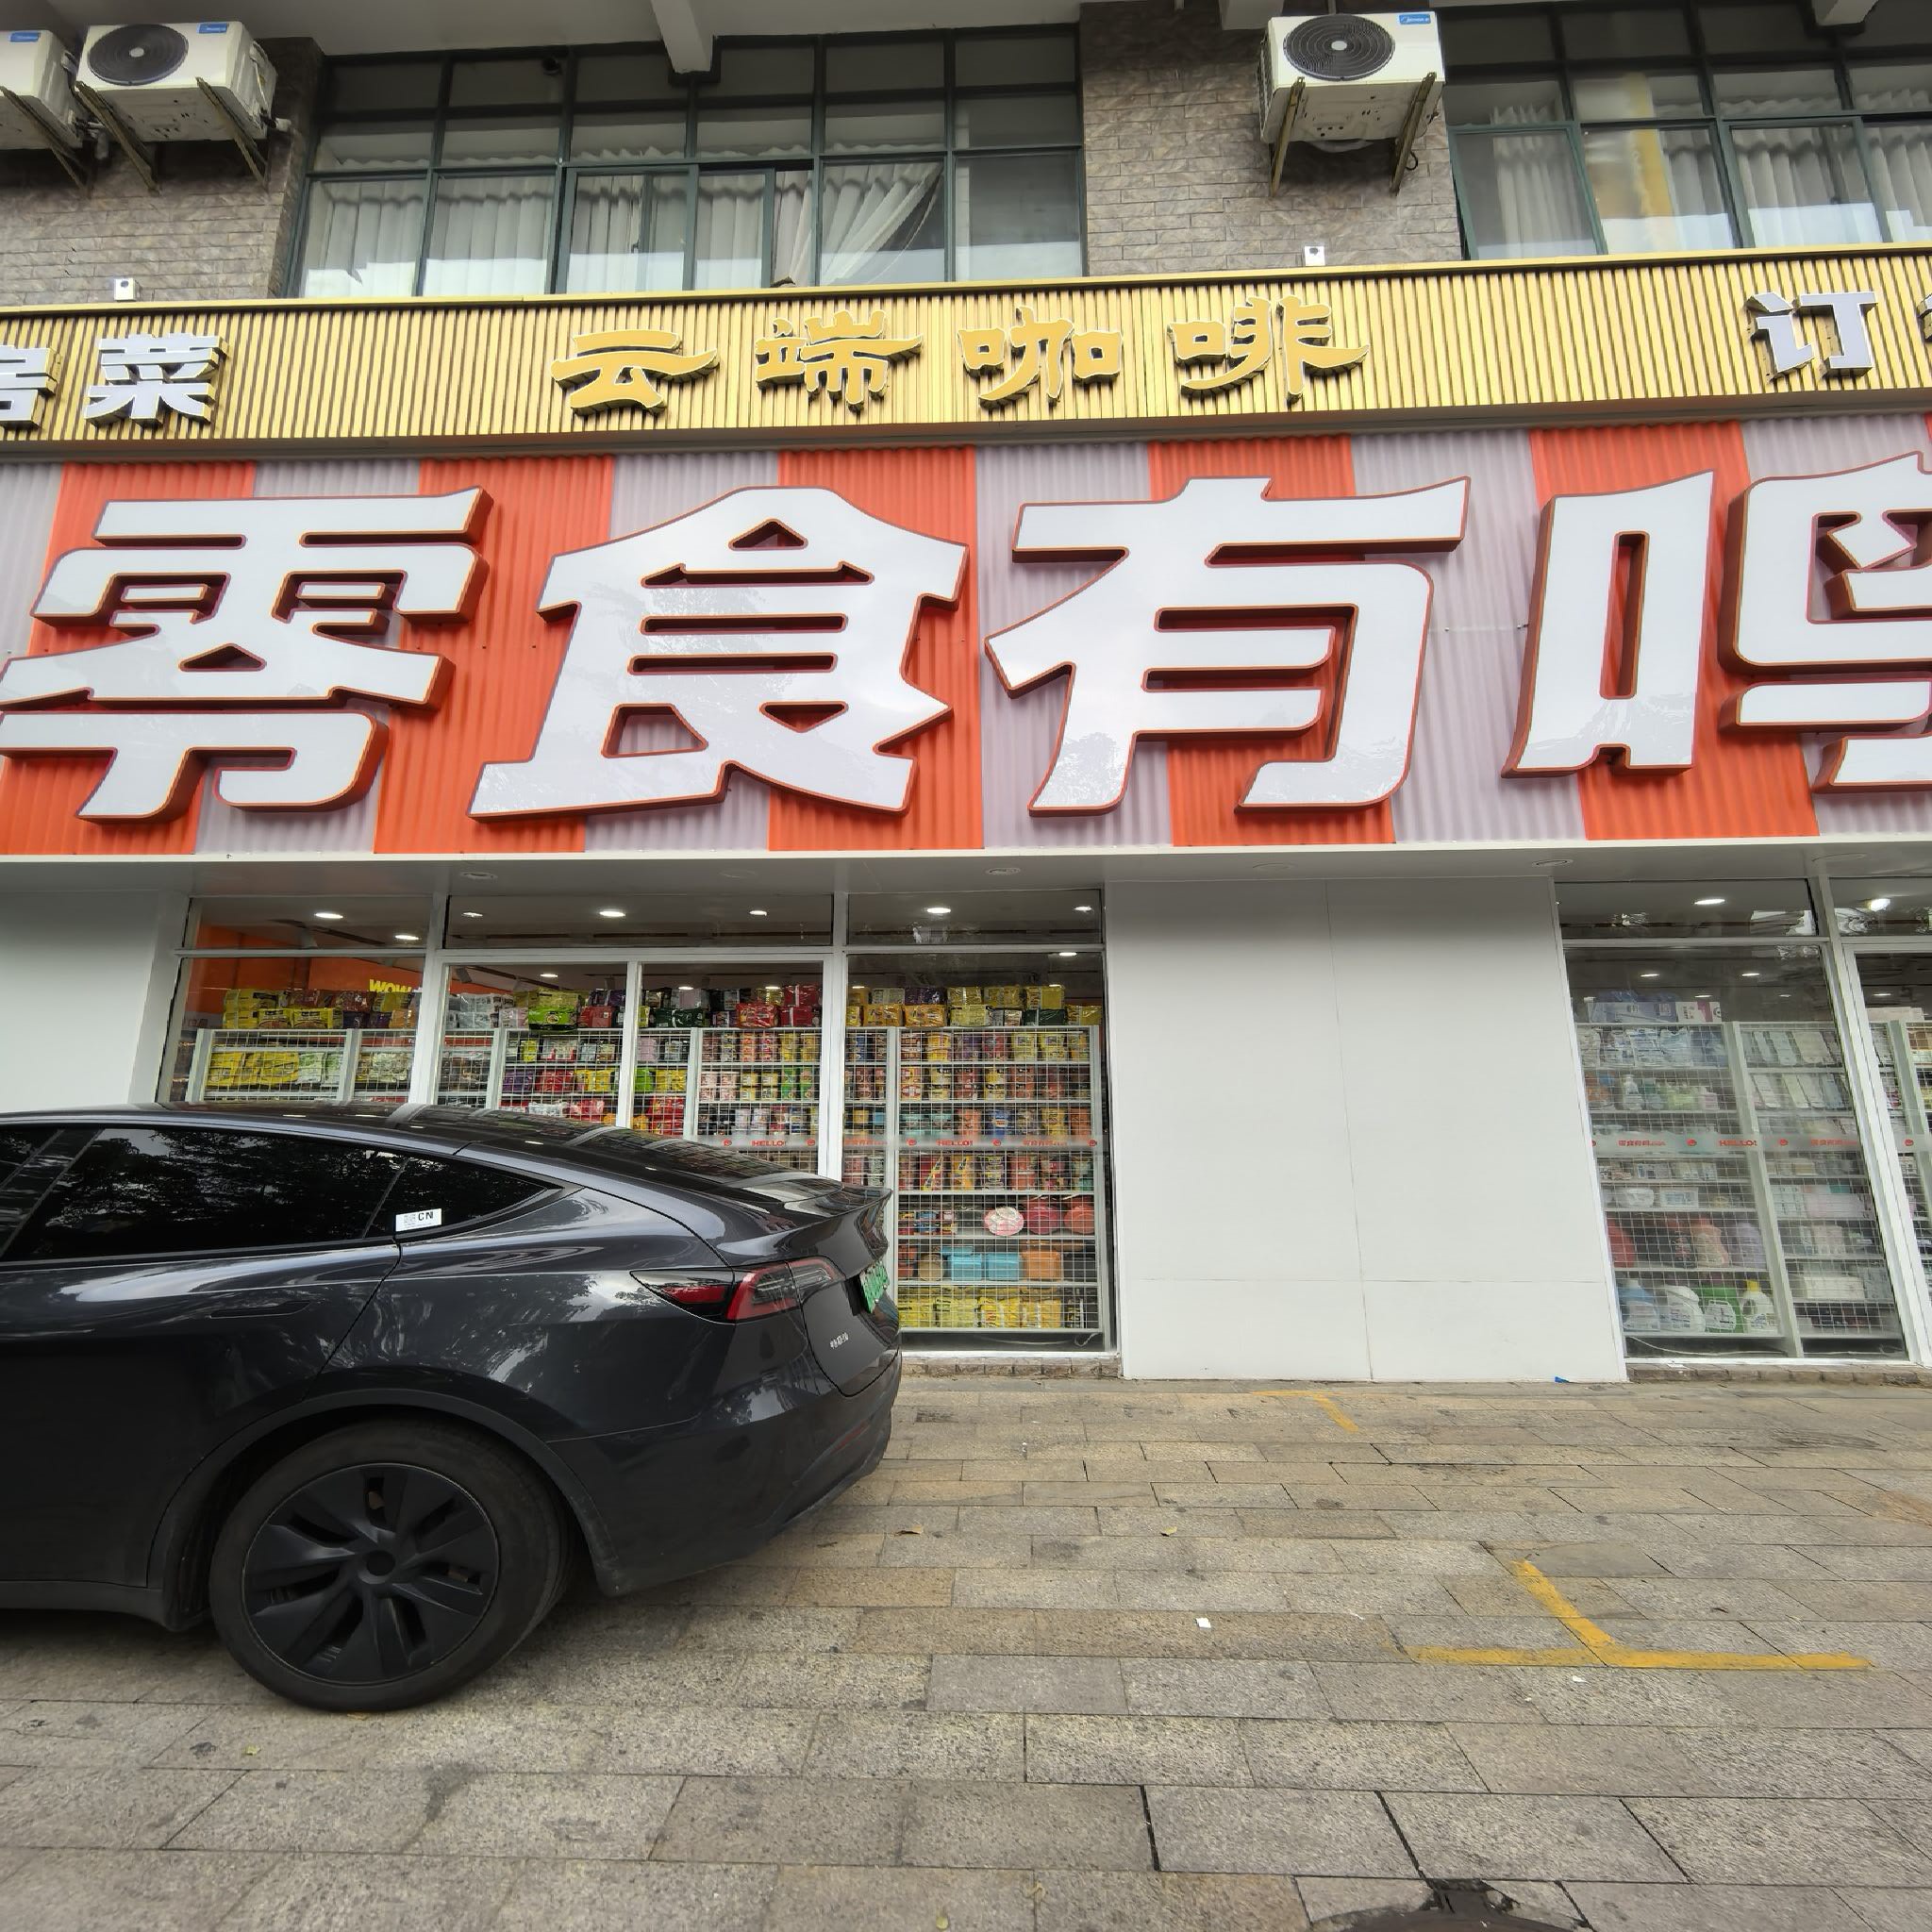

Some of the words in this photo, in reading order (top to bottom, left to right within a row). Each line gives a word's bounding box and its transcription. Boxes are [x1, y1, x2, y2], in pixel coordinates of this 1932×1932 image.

[550, 294, 1371, 416] 云端咖啡
[1747, 291, 1932, 379] 订
[418, 1210, 434, 1222] CN
